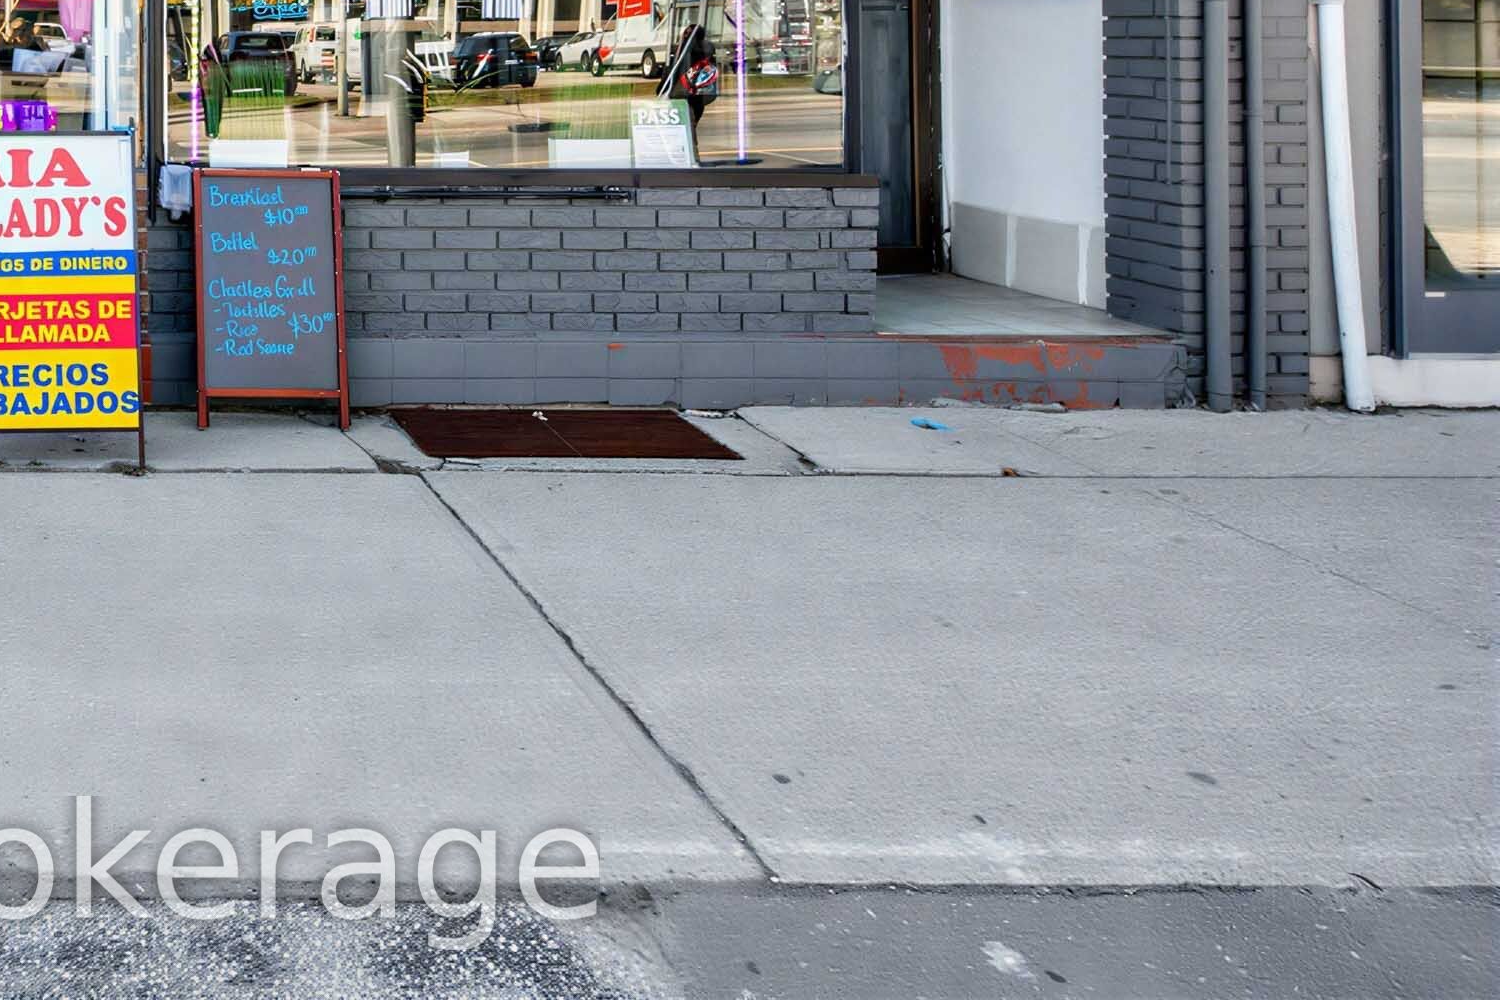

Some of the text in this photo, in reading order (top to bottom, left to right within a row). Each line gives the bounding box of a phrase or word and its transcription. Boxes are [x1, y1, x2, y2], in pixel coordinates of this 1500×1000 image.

[637, 106, 683, 127] PASS
[30, 257, 54, 272] DE
[58, 255, 129, 272] DINERO
[99, 300, 132, 319] DE
